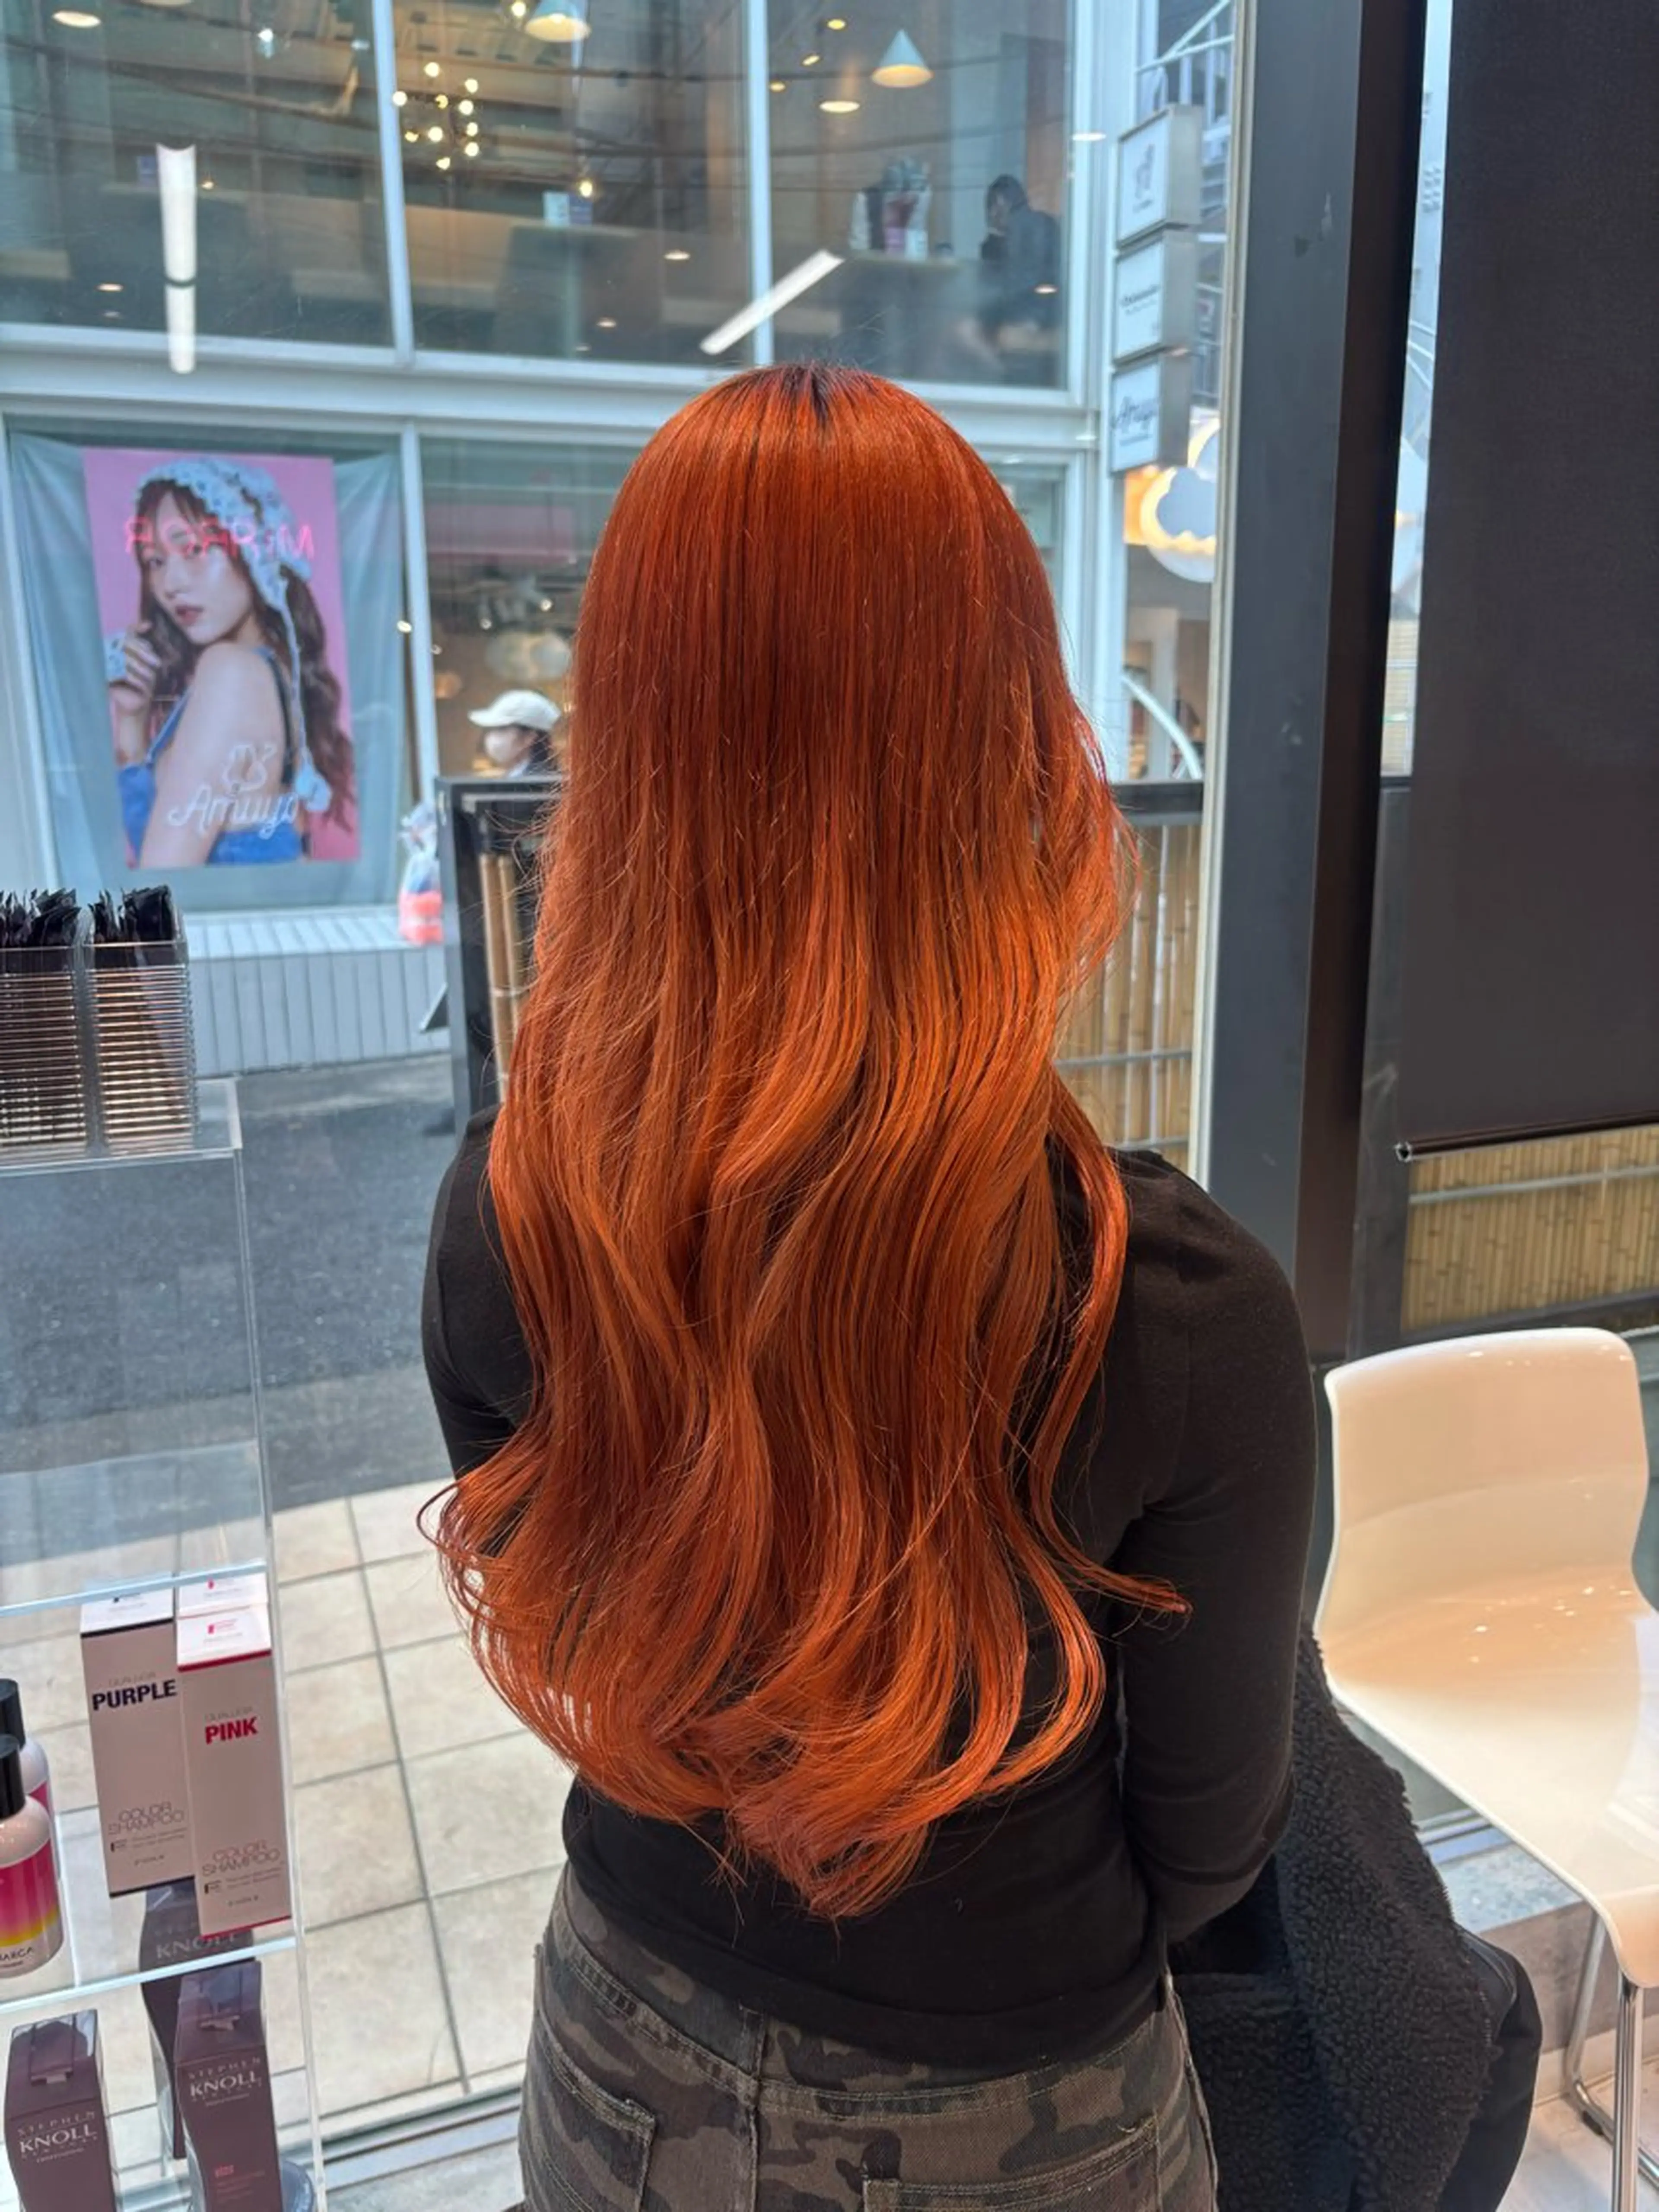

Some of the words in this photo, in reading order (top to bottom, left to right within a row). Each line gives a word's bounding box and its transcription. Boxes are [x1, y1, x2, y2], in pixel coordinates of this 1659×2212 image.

[92, 1679, 177, 1711] PURPLE
[205, 1716, 258, 1745] PINK
[108, 1810, 184, 1835] SHAMPOO
[118, 1801, 172, 1822] COLOR
[202, 1848, 281, 1878] SHAMPOO
[213, 1839, 267, 1862] COLOR
[190, 2070, 259, 2097] KNOLL
[19, 2123, 97, 2153] KNOLL
